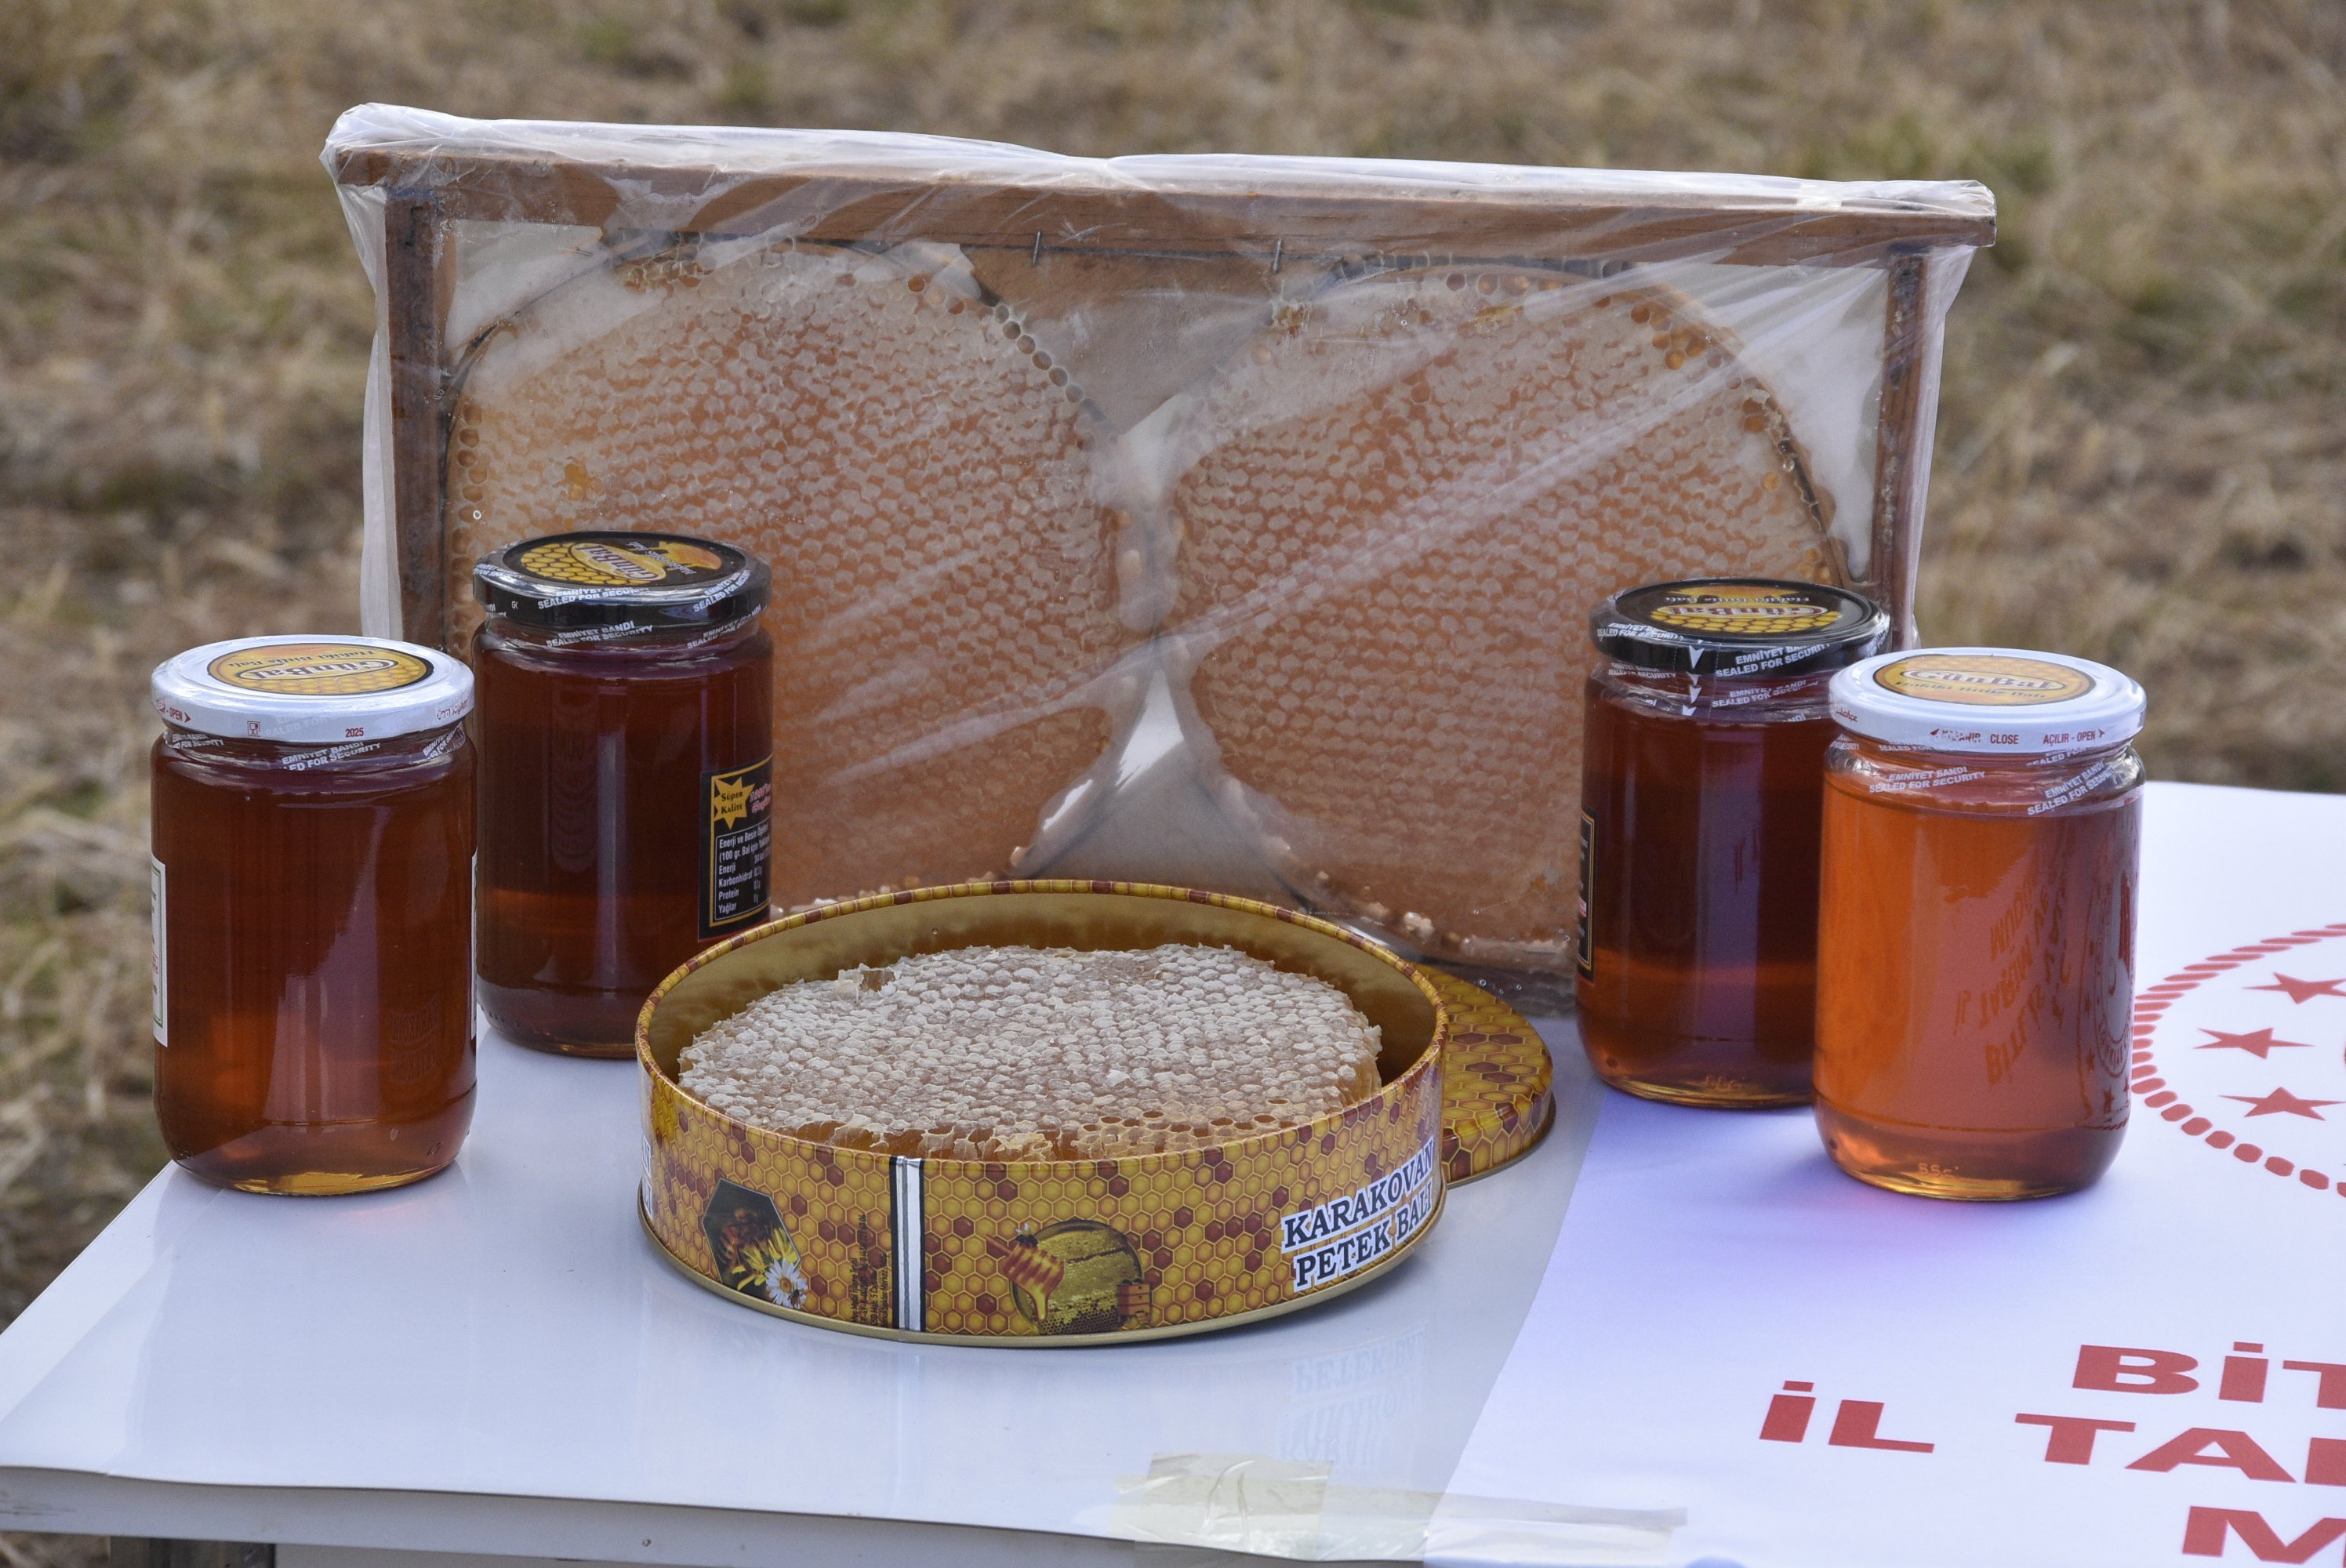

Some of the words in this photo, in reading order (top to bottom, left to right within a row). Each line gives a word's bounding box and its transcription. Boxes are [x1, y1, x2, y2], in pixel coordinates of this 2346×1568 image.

[537, 595, 577, 609] SEALED
[693, 591, 726, 612] SEALED
[724, 583, 738, 594] FOR
[601, 620, 635, 633] BANDI
[602, 625, 653, 640] SECURITY
[1735, 647, 1785, 664] EMNİYET
[250, 659, 390, 680] GünBal
[1716, 663, 1759, 677] SEALED
[1761, 658, 1784, 670] FOR
[1909, 670, 2051, 689] GünBal
[1712, 696, 1750, 708] SEALED
[345, 728, 365, 738] 2025
[1990, 733, 2019, 745] CLOSE
[2043, 733, 2069, 746] AÇILIR
[2076, 730, 2096, 742] OPEN
[282, 748, 329, 765] EMNİYET
[330, 742, 365, 754] BANDI
[307, 756, 329, 768] FOR
[329, 742, 381, 761] SECURITY
[1869, 782, 1906, 793] SEALED
[1908, 780, 1930, 789] FOR
[1932, 771, 1986, 786] SECURITY
[1888, 770, 1935, 782] EMNİYET
[1935, 766, 1968, 779] BANDI
[2045, 775, 2083, 799] EMNİYET
[2027, 795, 2068, 815] SEALED
[2068, 785, 2089, 800] FOR
[719, 836, 736, 848] Enerji
[737, 836, 744, 844] ve
[719, 850, 733, 862] (100
[742, 845, 750, 856] Bal
[718, 862, 736, 875] Enerji
[718, 870, 753, 887] Karbonhidrat
[718, 888, 739, 901] Protein
[718, 902, 737, 915] Yağlar
[1283, 1141, 1434, 1250] KARAKOVAN
[1296, 1222, 1391, 1287] PETEK
[1396, 1181, 1433, 1241] BALI
[2072, 1340, 2346, 1410] BİT
[1759, 1380, 1935, 1454] İL
